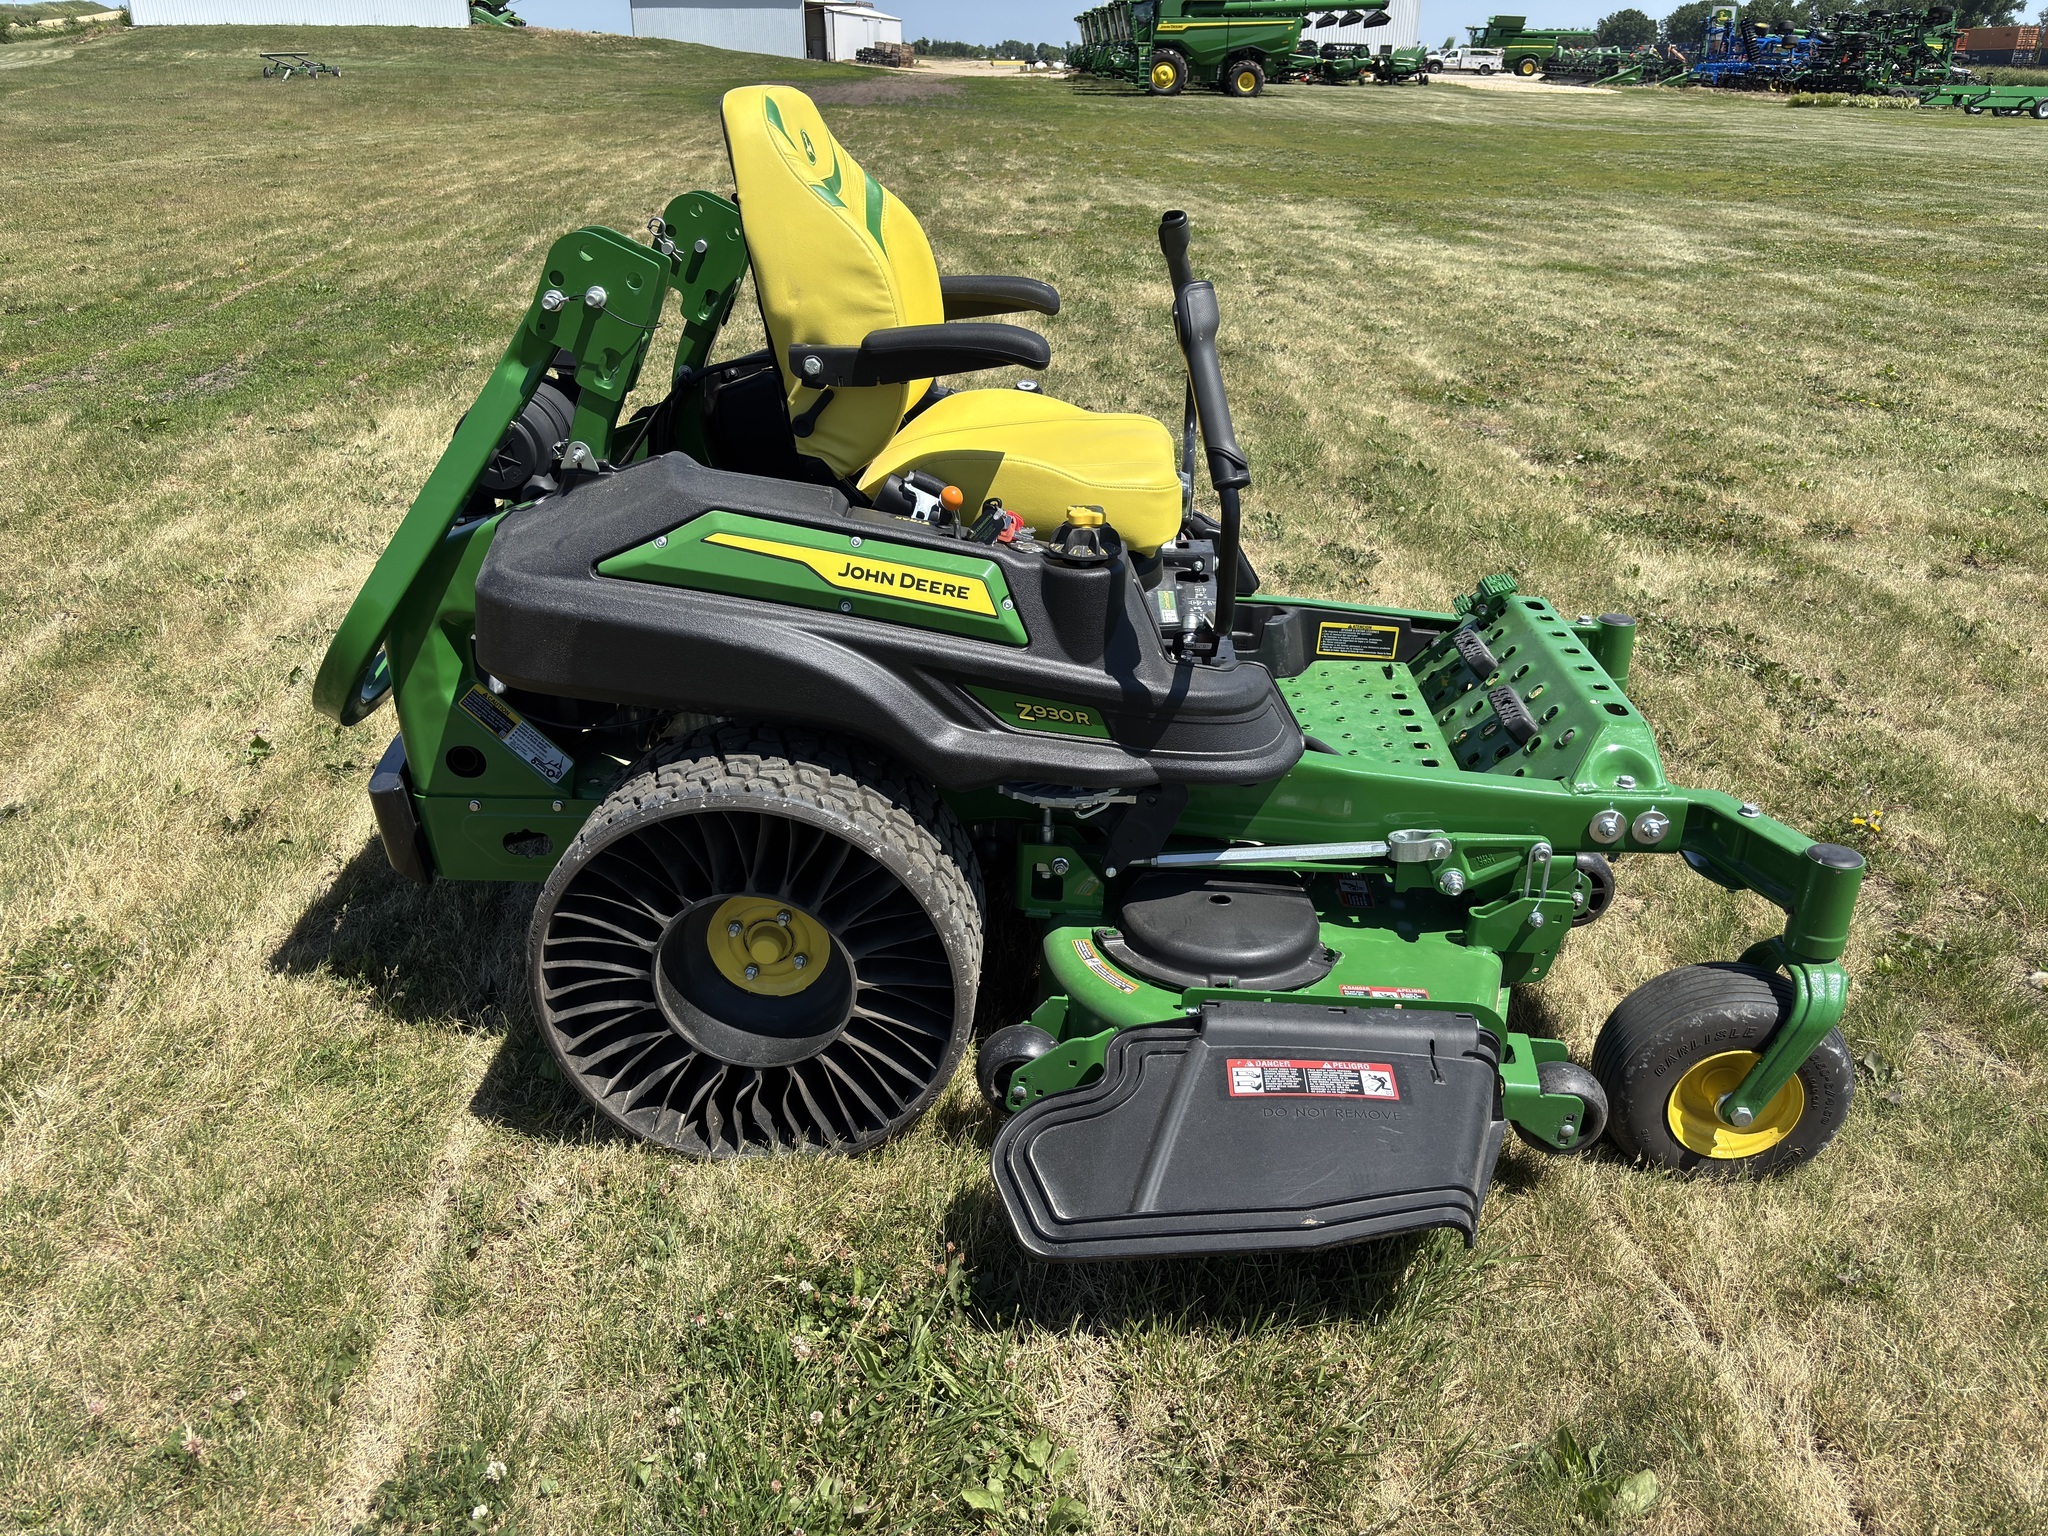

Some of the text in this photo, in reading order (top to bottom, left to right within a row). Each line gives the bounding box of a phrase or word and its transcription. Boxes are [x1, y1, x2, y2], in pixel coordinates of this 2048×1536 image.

[838, 562, 970, 599] JOHN DEERE
[487, 695, 511, 716] CAUTION
[1015, 702, 1091, 726] Z930R
[1653, 1026, 1758, 1077] CARLISLE
[1255, 1060, 1291, 1068] DANGER
[1332, 1061, 1370, 1070] PELIGRO
[1262, 1107, 1402, 1121] DO NOT REMOVE
